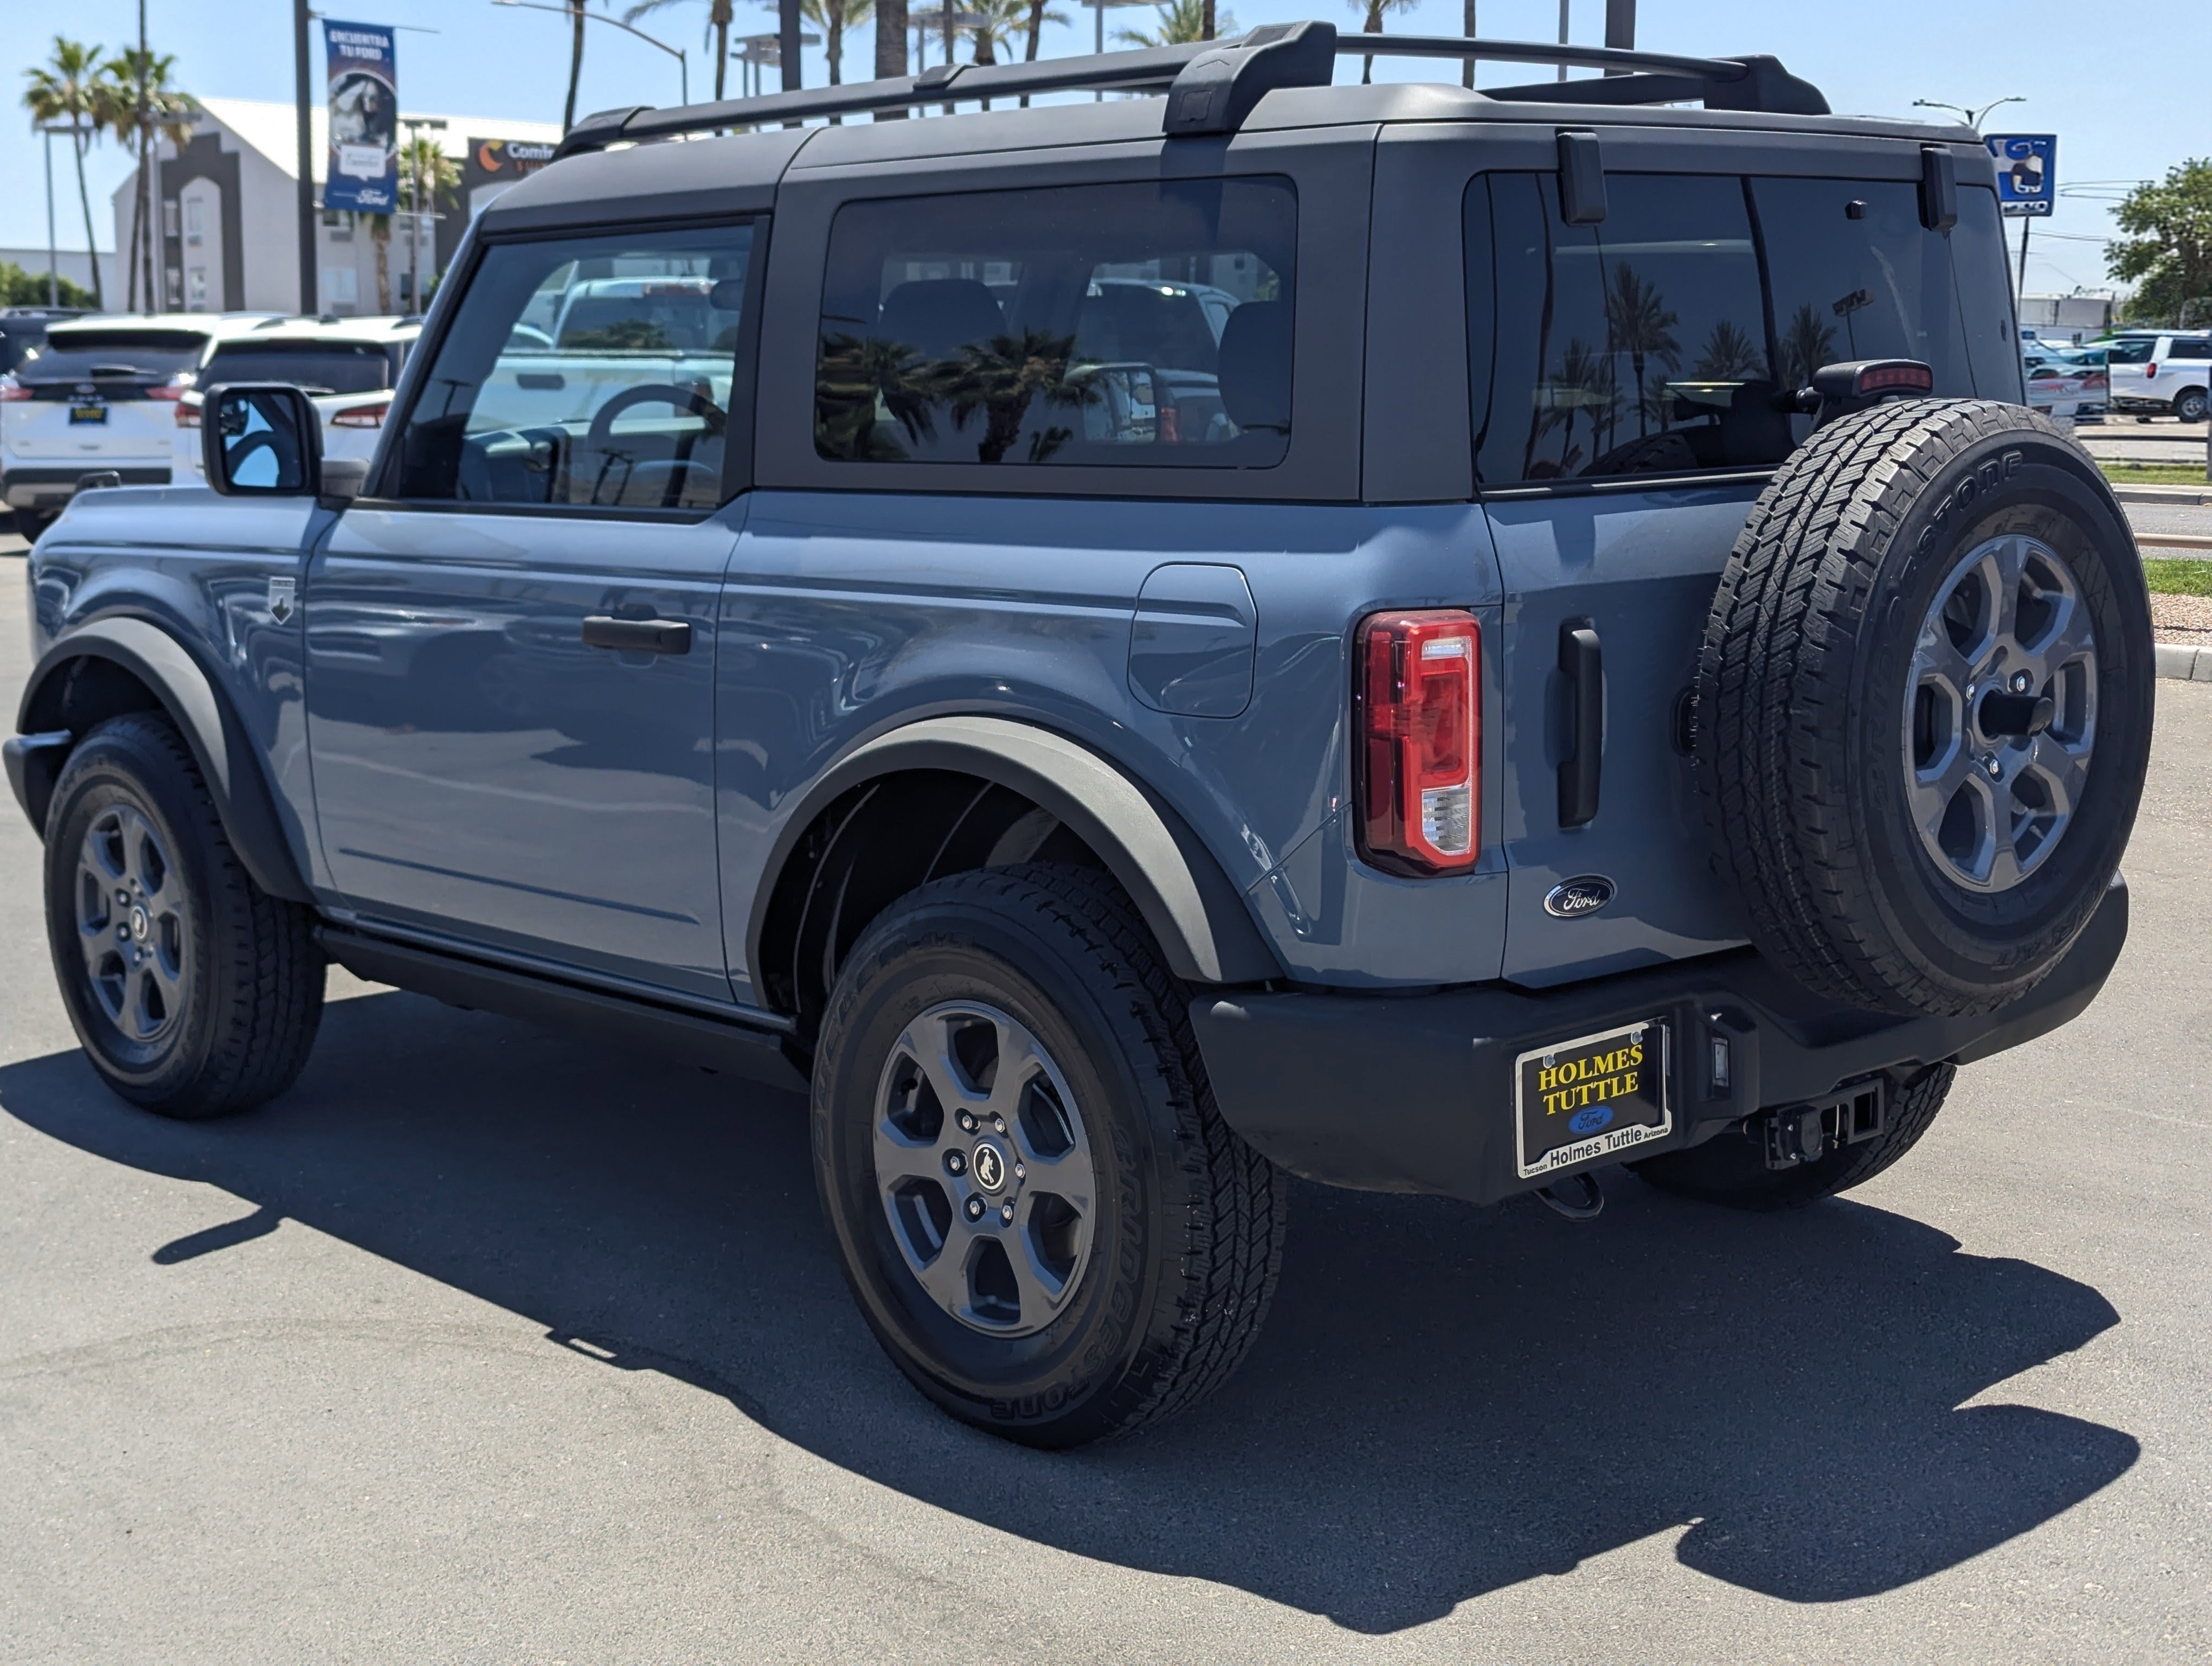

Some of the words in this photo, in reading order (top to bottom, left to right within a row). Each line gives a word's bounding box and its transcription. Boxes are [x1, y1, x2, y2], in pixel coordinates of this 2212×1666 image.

[1563, 888, 1600, 911] Ford
[1538, 1045, 1643, 1092] HOLMES
[1543, 1072, 1638, 1116] TUTTLE
[1578, 1111, 1604, 1130] Ford
[1523, 1163, 1548, 1176] Tucson
[1550, 1141, 1601, 1168] Holmes
[1605, 1128, 1642, 1150] Tuttle
[1643, 1127, 1669, 1139] Arizona
[991, 1123, 1142, 1420] BRIDGESTONE
